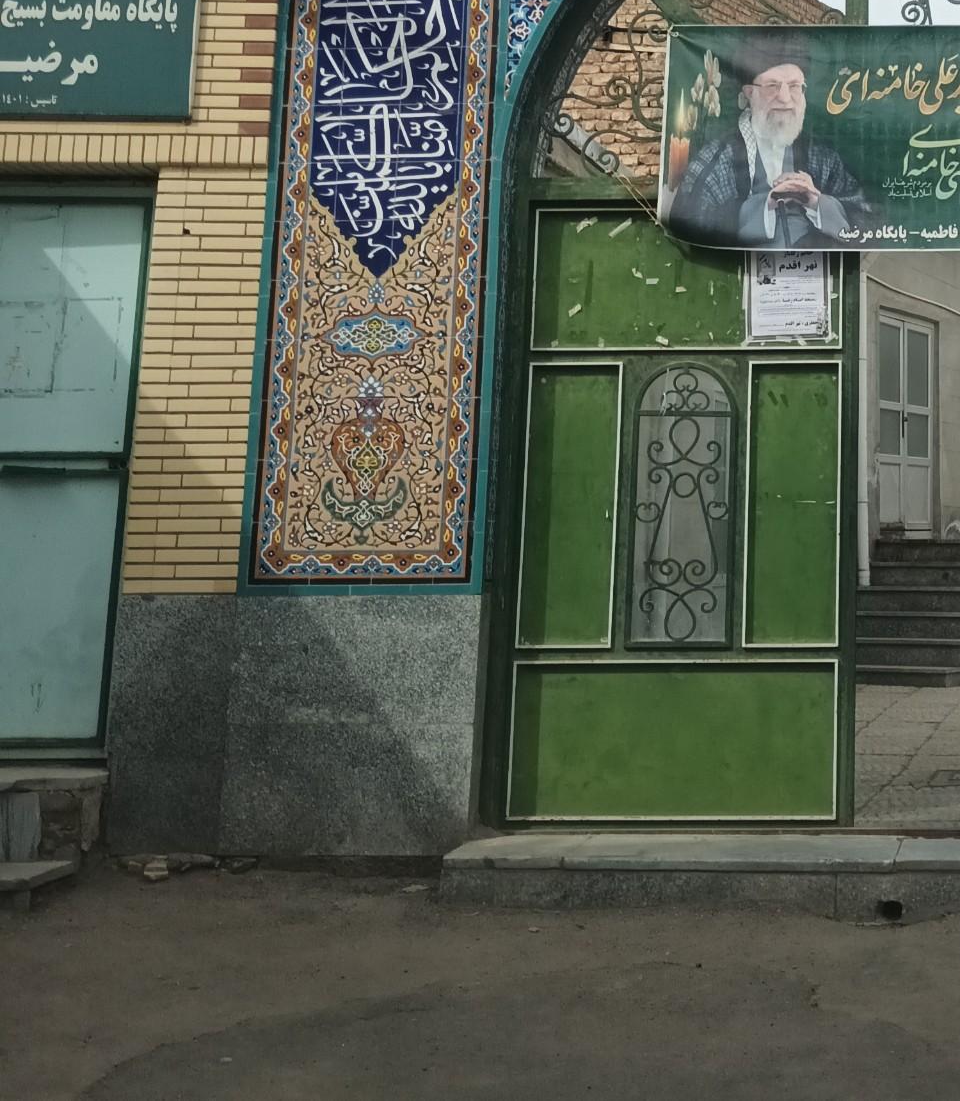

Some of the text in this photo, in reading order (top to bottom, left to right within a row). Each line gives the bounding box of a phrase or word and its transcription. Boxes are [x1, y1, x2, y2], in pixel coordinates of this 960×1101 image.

[0, 40, 99, 85] مرضی
[918, 54, 959, 115] علی
[839, 225, 873, 243] مرضیه
[876, 225, 907, 243] پایگاه
